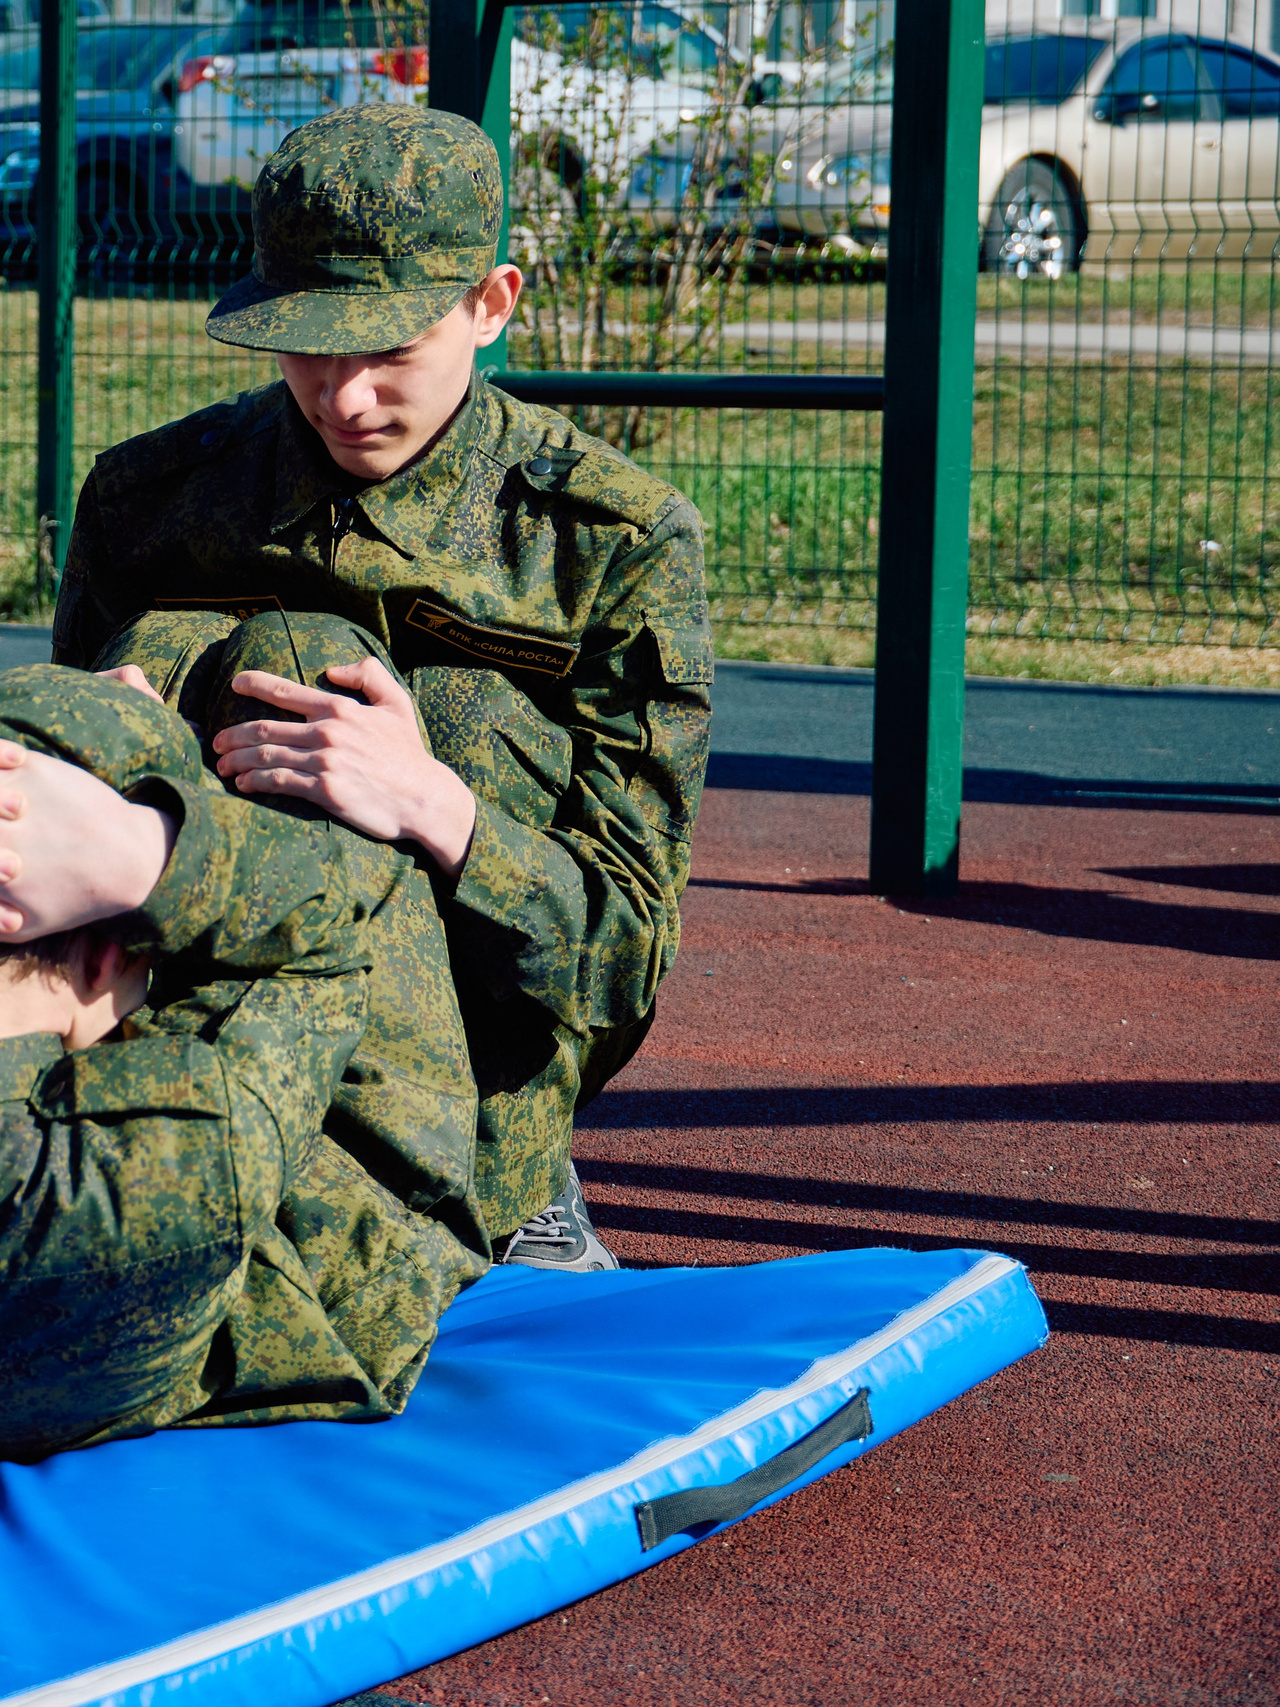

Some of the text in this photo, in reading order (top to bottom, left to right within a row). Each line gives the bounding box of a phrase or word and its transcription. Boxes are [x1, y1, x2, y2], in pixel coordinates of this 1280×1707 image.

[448, 628, 564, 666] ВПК «СИЛА РОСТА»
